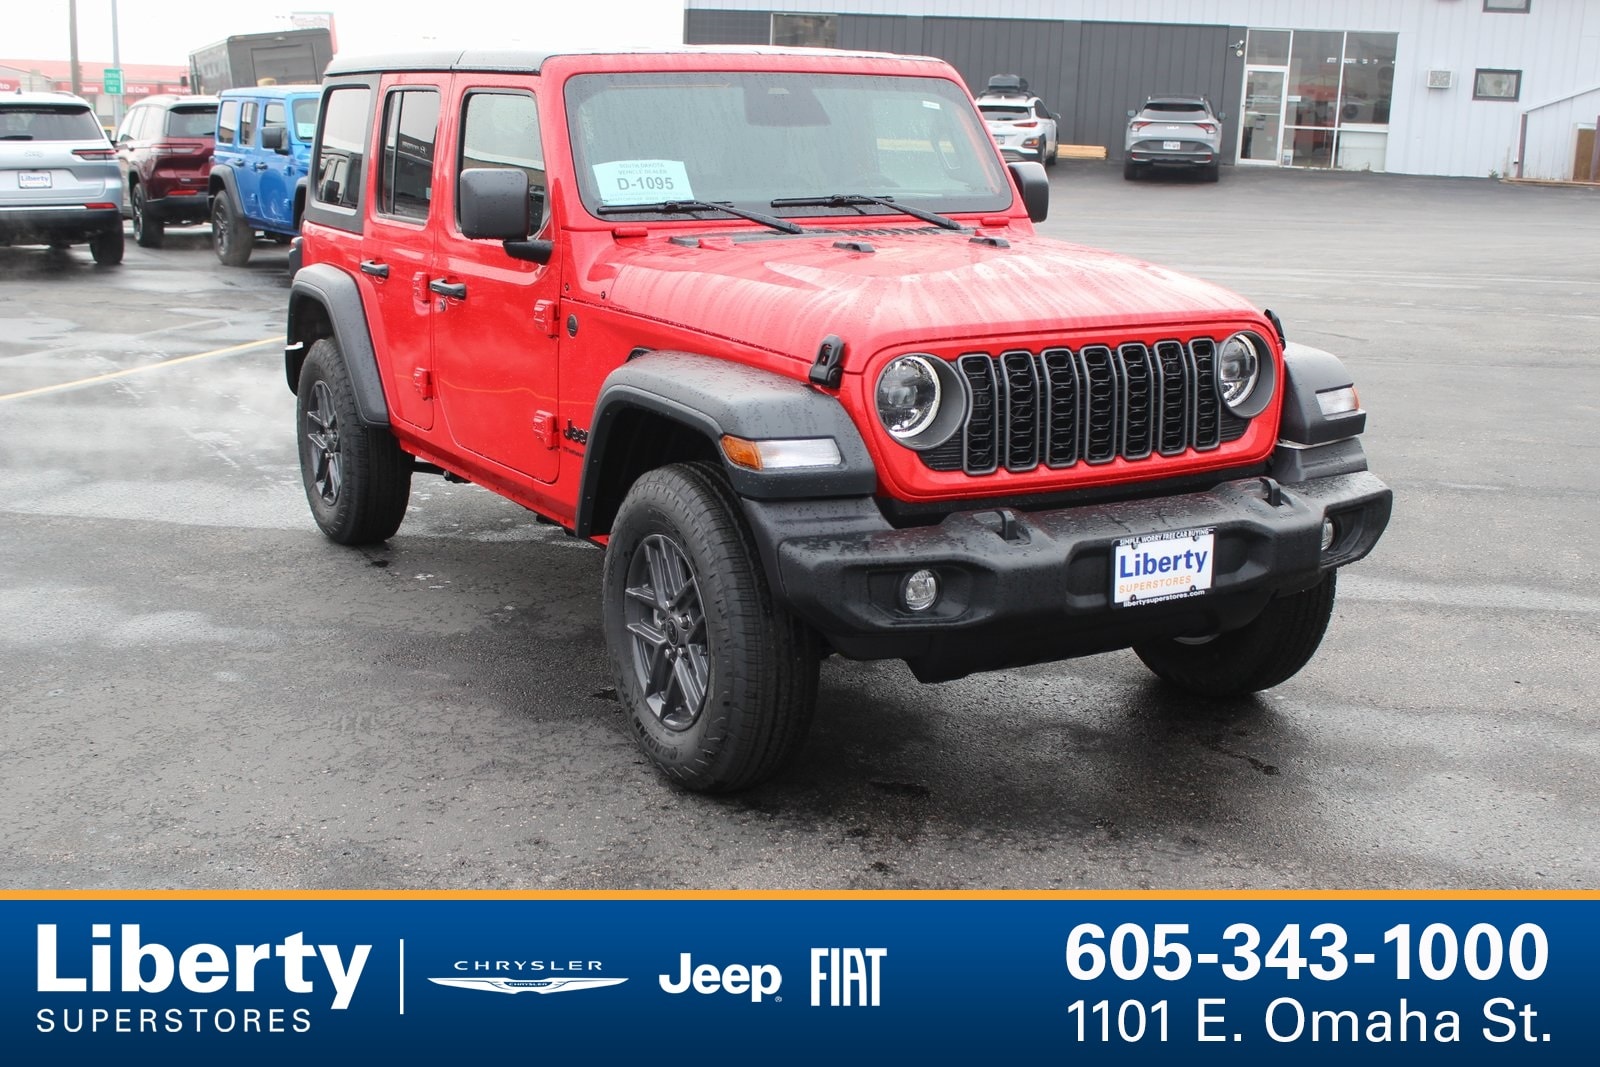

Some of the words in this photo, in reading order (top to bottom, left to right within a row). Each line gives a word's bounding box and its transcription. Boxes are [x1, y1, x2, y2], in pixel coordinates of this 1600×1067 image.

[617, 177, 674, 190] D-1095
[1141, 535, 1162, 544] WORRY
[1120, 549, 1208, 578] Liberty
[1119, 575, 1192, 594] SUPERSTORES
[1123, 590, 1205, 608] libertysuperstores.com
